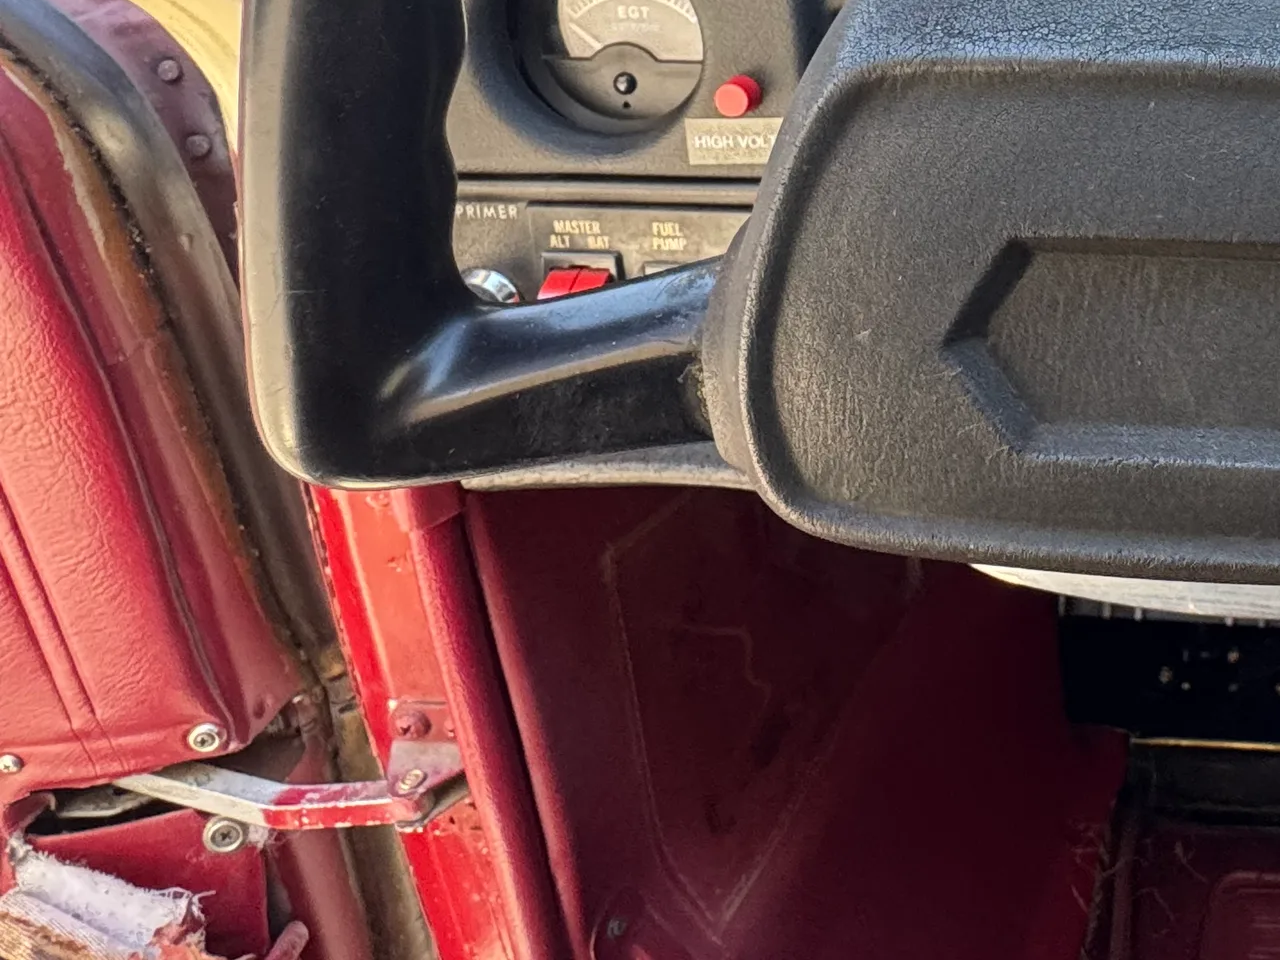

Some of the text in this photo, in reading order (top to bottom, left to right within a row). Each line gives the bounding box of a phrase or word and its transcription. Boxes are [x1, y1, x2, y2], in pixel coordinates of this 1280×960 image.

[616, 5, 651, 20] EGT
[693, 134, 735, 149] HIGH
[455, 203, 518, 220] PRIMER
[552, 219, 602, 235] MASTER
[651, 221, 684, 237] FUEL
[549, 234, 610, 249] ALT BAT
[652, 237, 688, 251] PUMP
